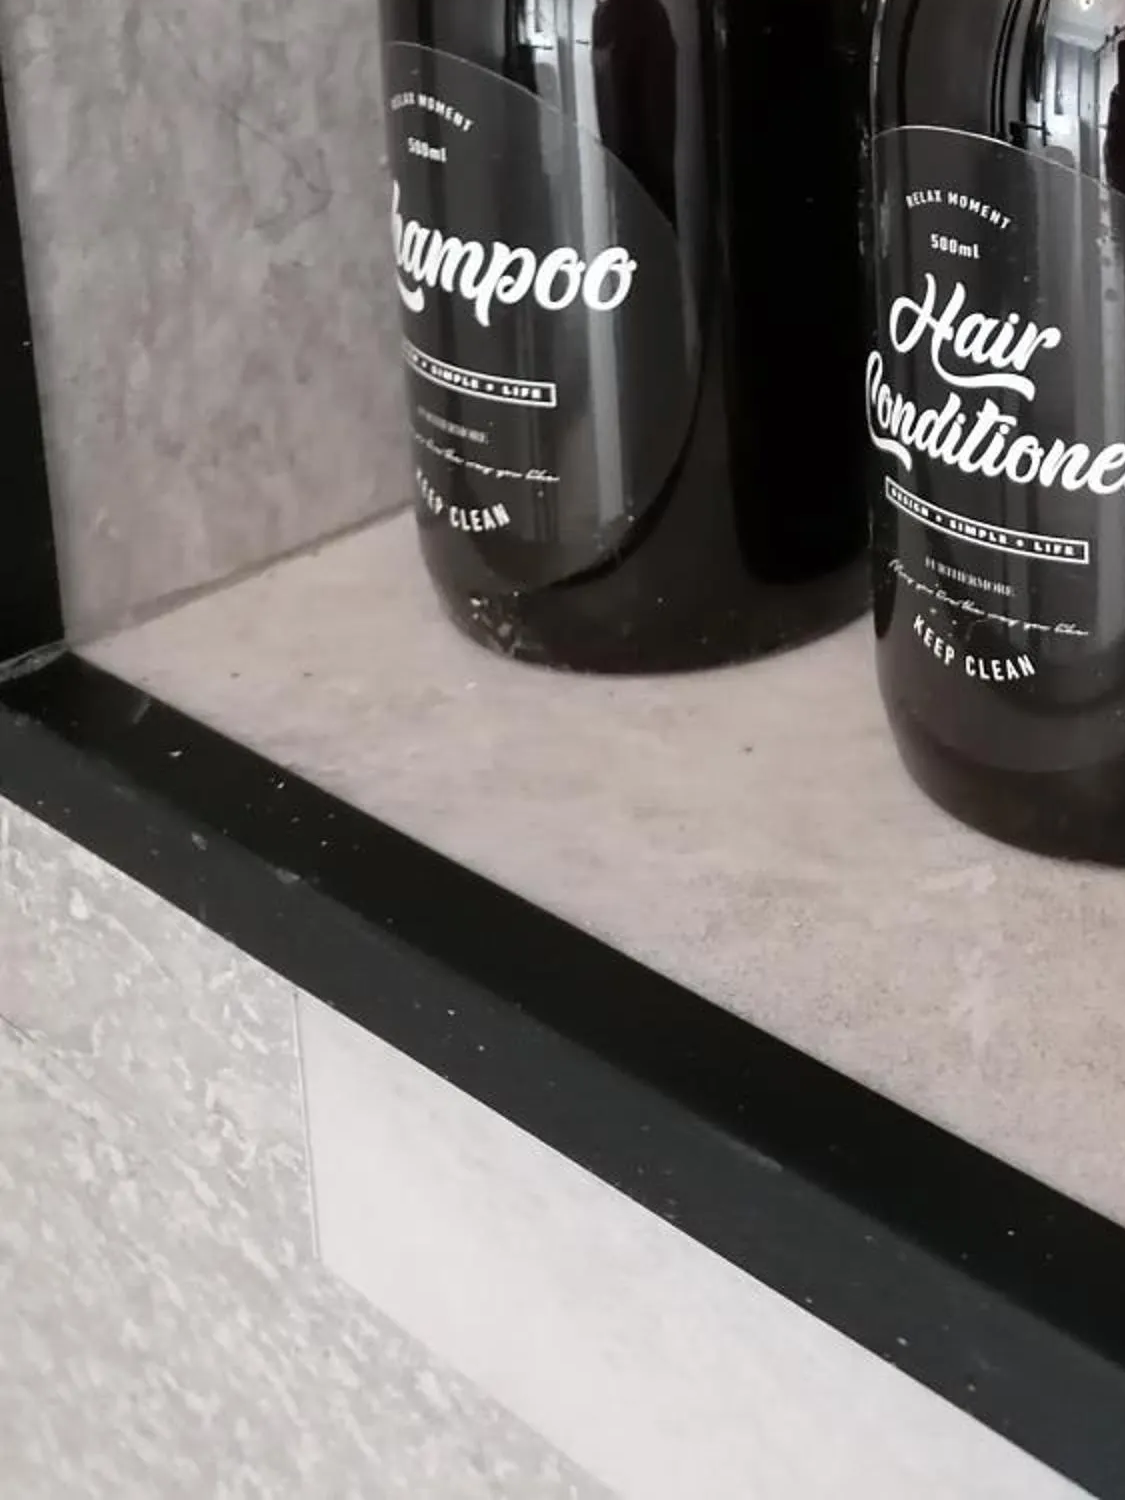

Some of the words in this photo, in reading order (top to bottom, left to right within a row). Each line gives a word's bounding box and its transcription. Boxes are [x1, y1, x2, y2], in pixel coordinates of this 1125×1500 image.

[905, 189, 942, 208] RELAX
[947, 190, 1012, 230] MOMENT
[930, 233, 980, 259] 500ml
[889, 272, 1062, 401] Hair
[502, 383, 542, 399] LIFE
[450, 503, 510, 532] CLEAN
[949, 519, 1007, 544] SIMPLE
[1033, 540, 1075, 556] LIFE
[913, 613, 955, 665] KEEP
[965, 653, 1036, 681] CLEAN
